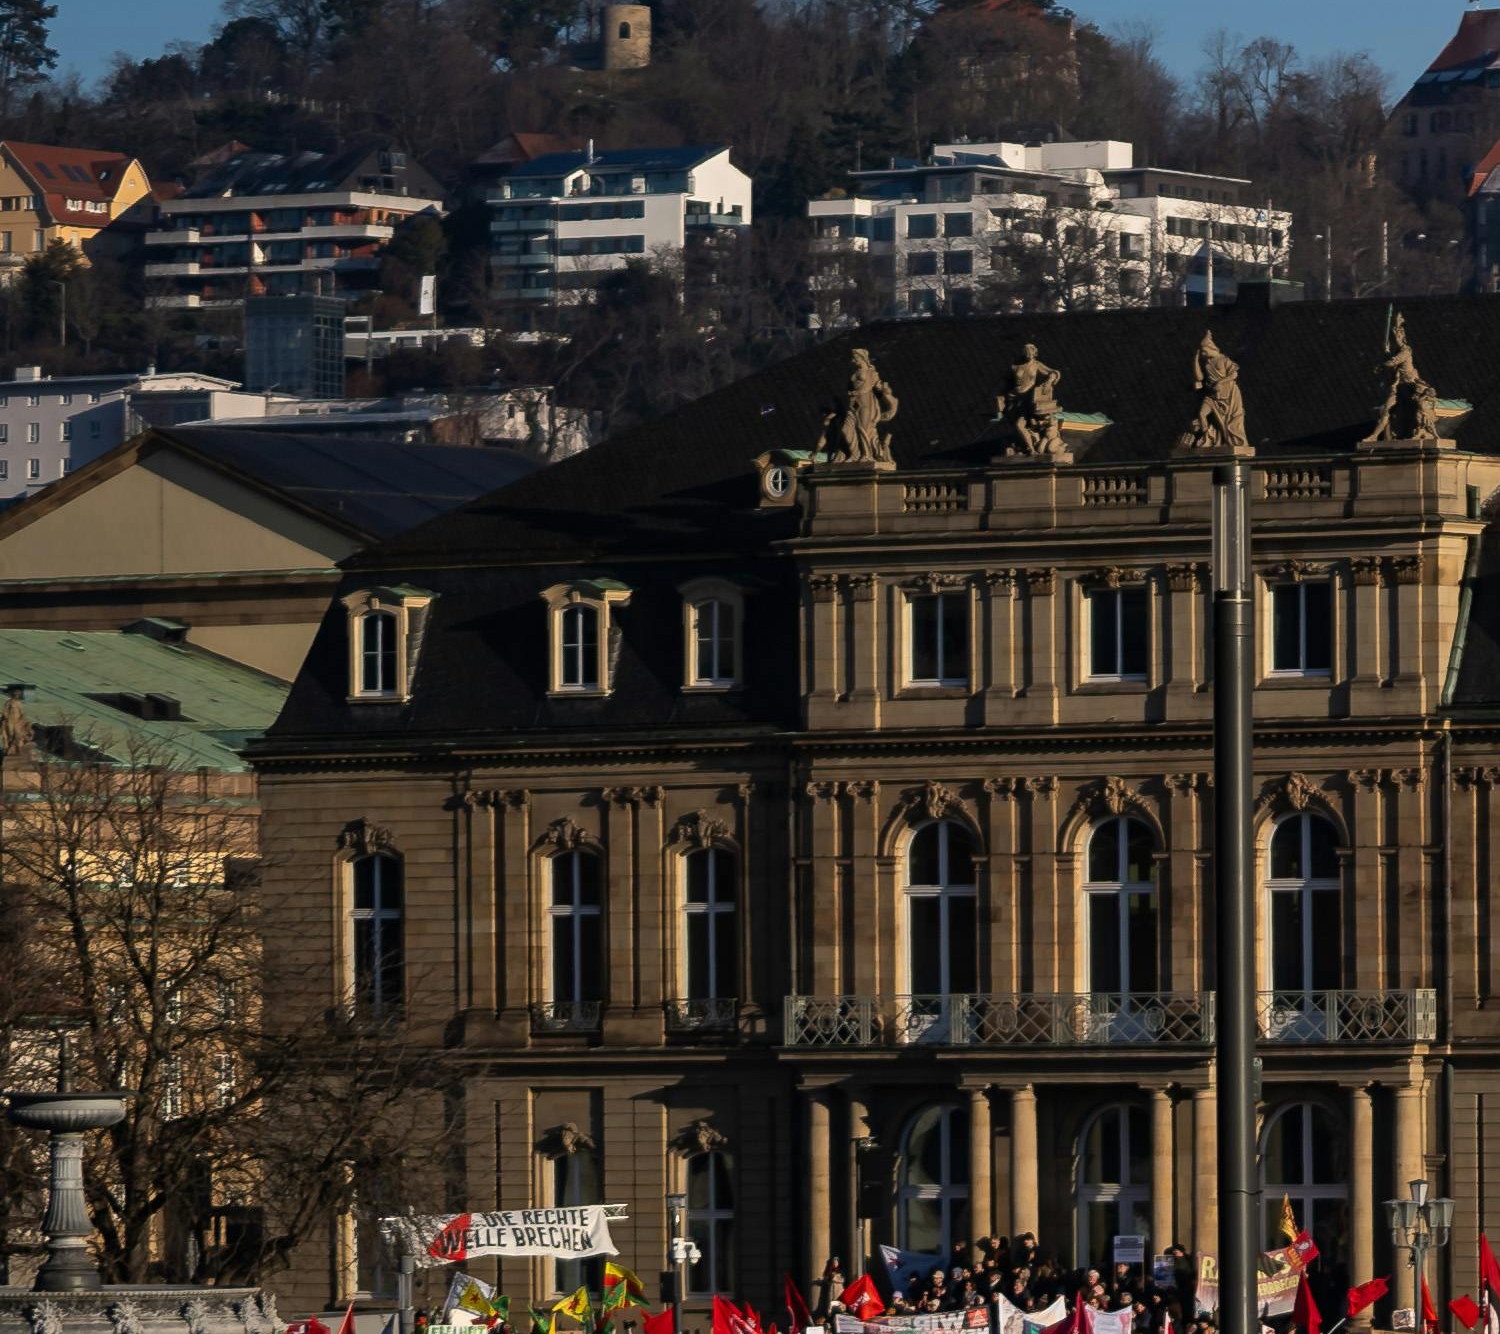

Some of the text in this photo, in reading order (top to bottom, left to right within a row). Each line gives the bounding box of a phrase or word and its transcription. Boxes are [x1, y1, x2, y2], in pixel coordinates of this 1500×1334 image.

[521, 1209, 589, 1227] RECHTE
[442, 1226, 594, 1254] WELLE BRECHEN
